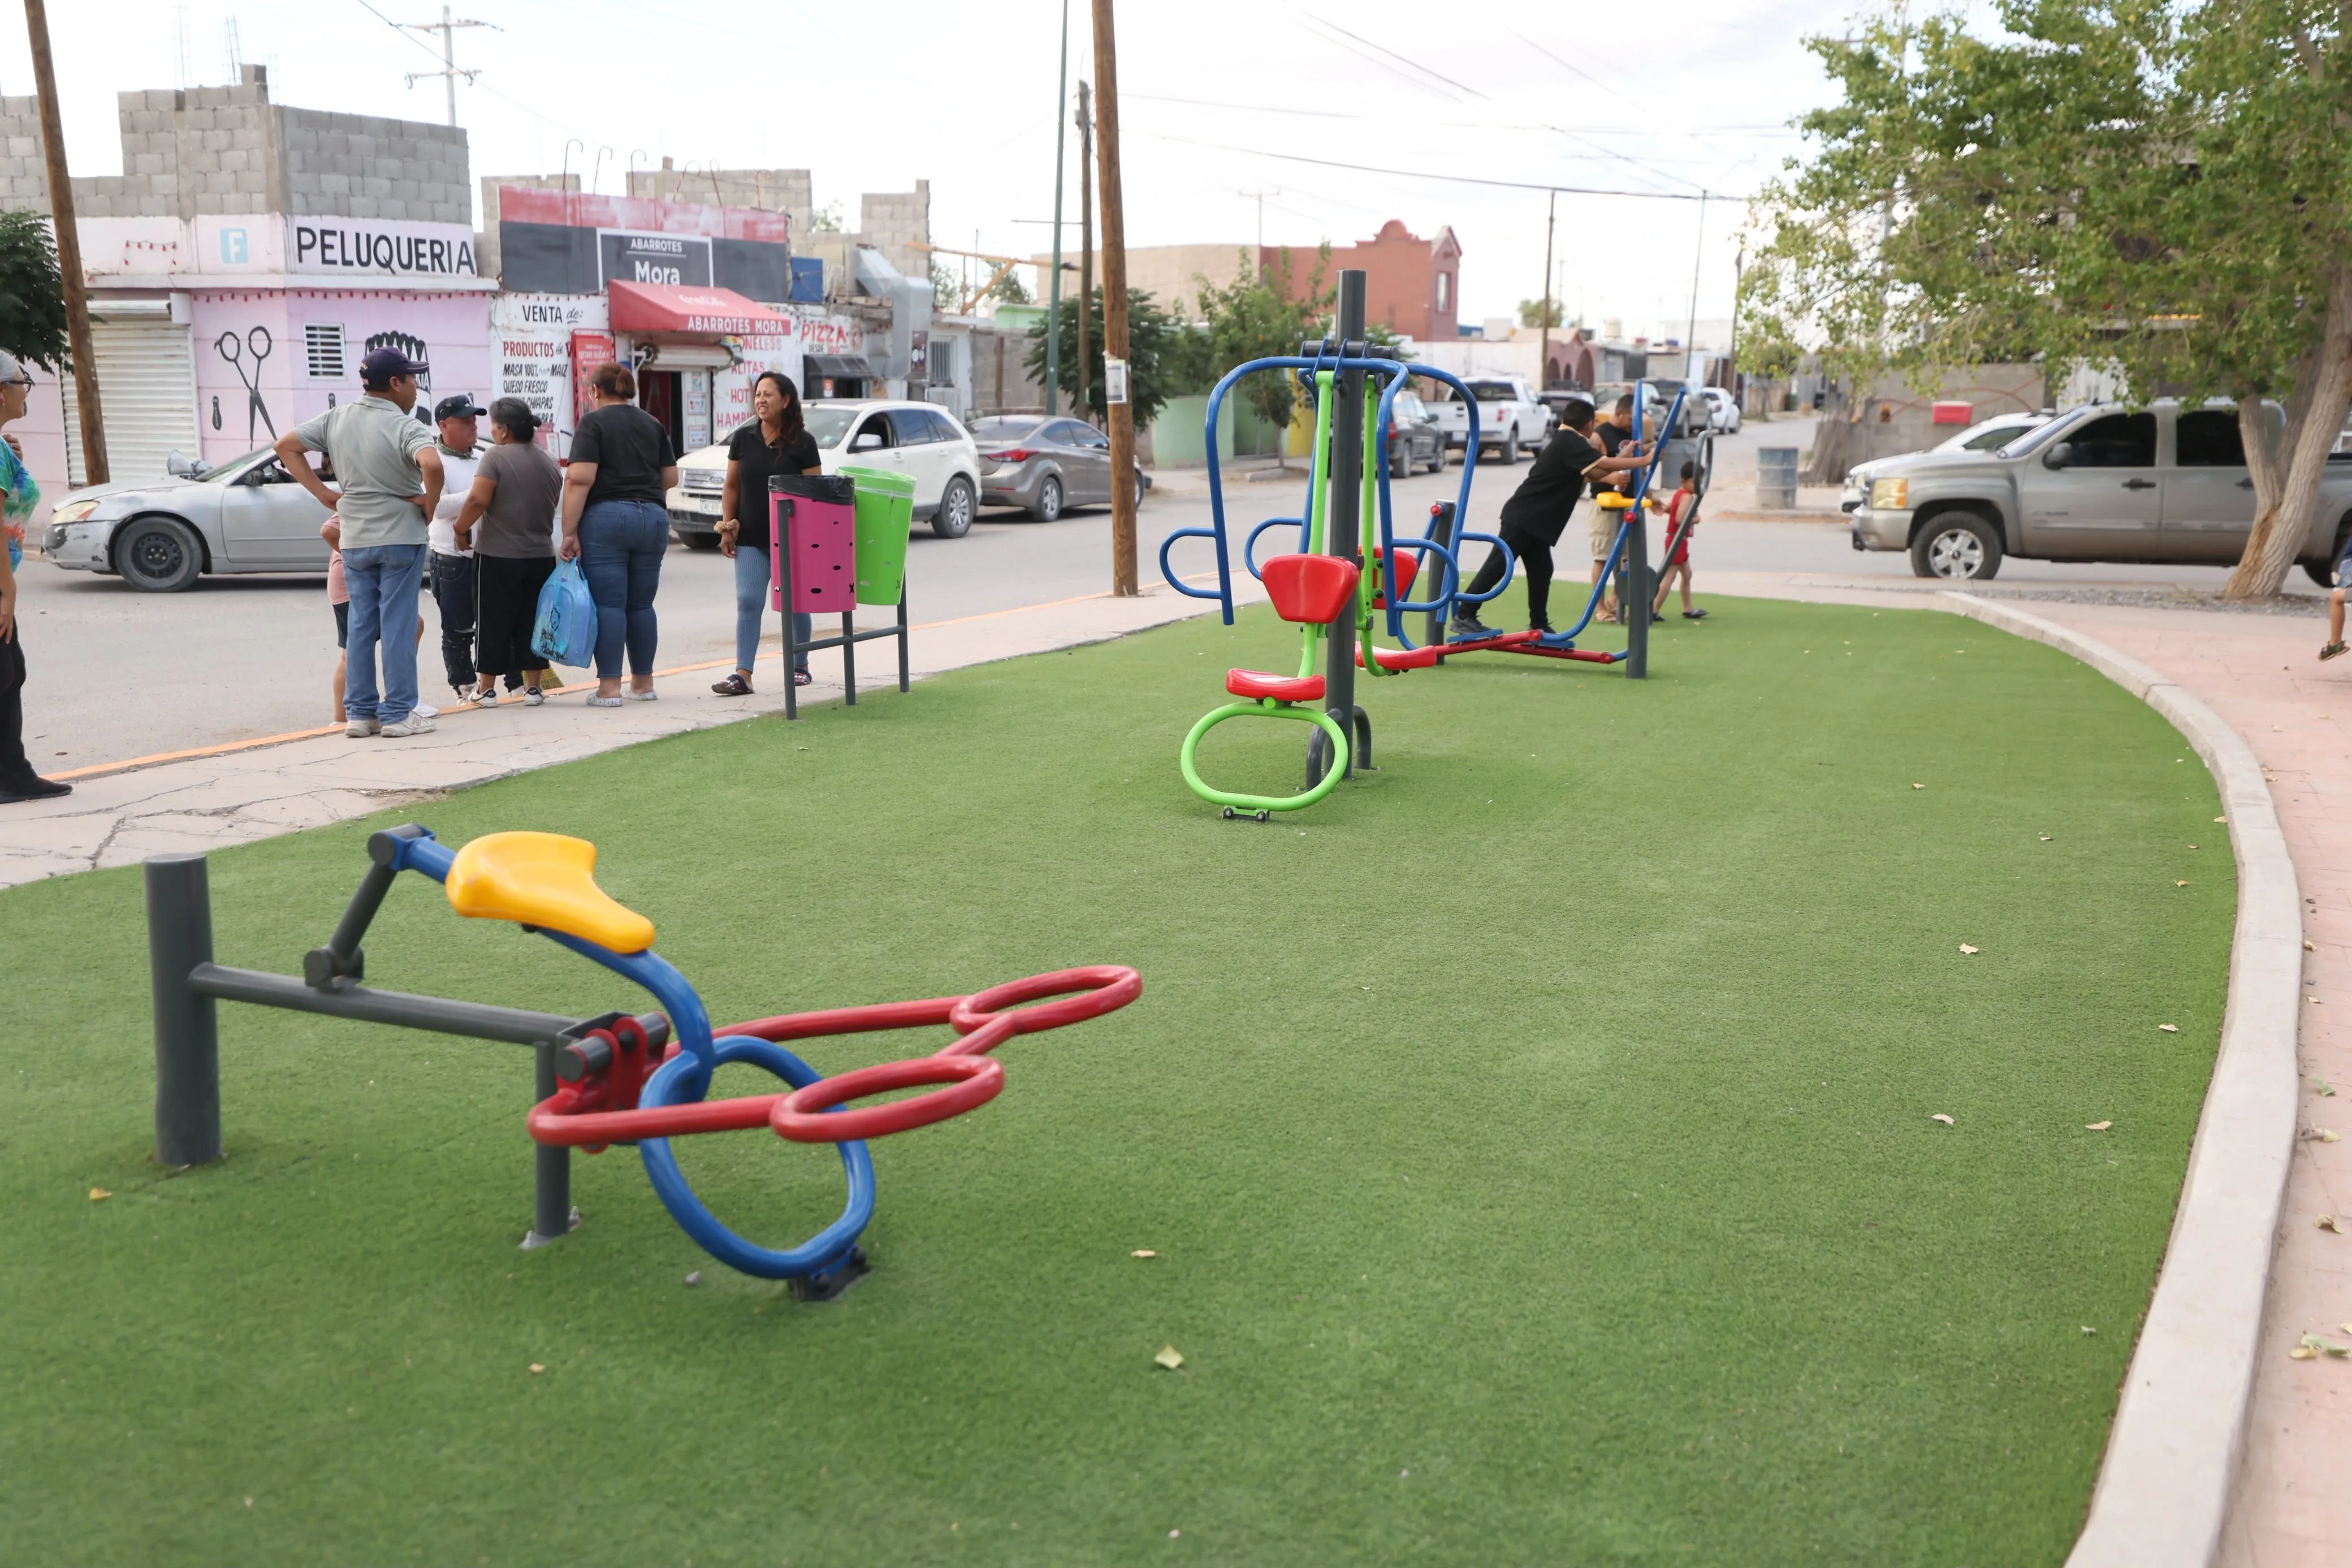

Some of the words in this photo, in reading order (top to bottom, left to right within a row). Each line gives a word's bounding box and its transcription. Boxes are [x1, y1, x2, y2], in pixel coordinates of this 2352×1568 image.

[297, 227, 475, 275] PELUQUERIA
[631, 238, 682, 253] ABARROTES
[635, 261, 680, 285] Mora
[522, 305, 563, 323] VENTA
[688, 316, 750, 332] ABARROTES
[755, 320, 783, 333] MORA
[801, 323, 846, 343] PIZZA
[504, 341, 554, 357] PRODUCTOS
[503, 363, 523, 376] MASA
[550, 364, 568, 377] MAIZ
[503, 380, 523, 393] QUESO
[524, 380, 548, 393] FRESCO
[526, 396, 553, 410] CHIAPAS
[731, 388, 749, 403] HOT
